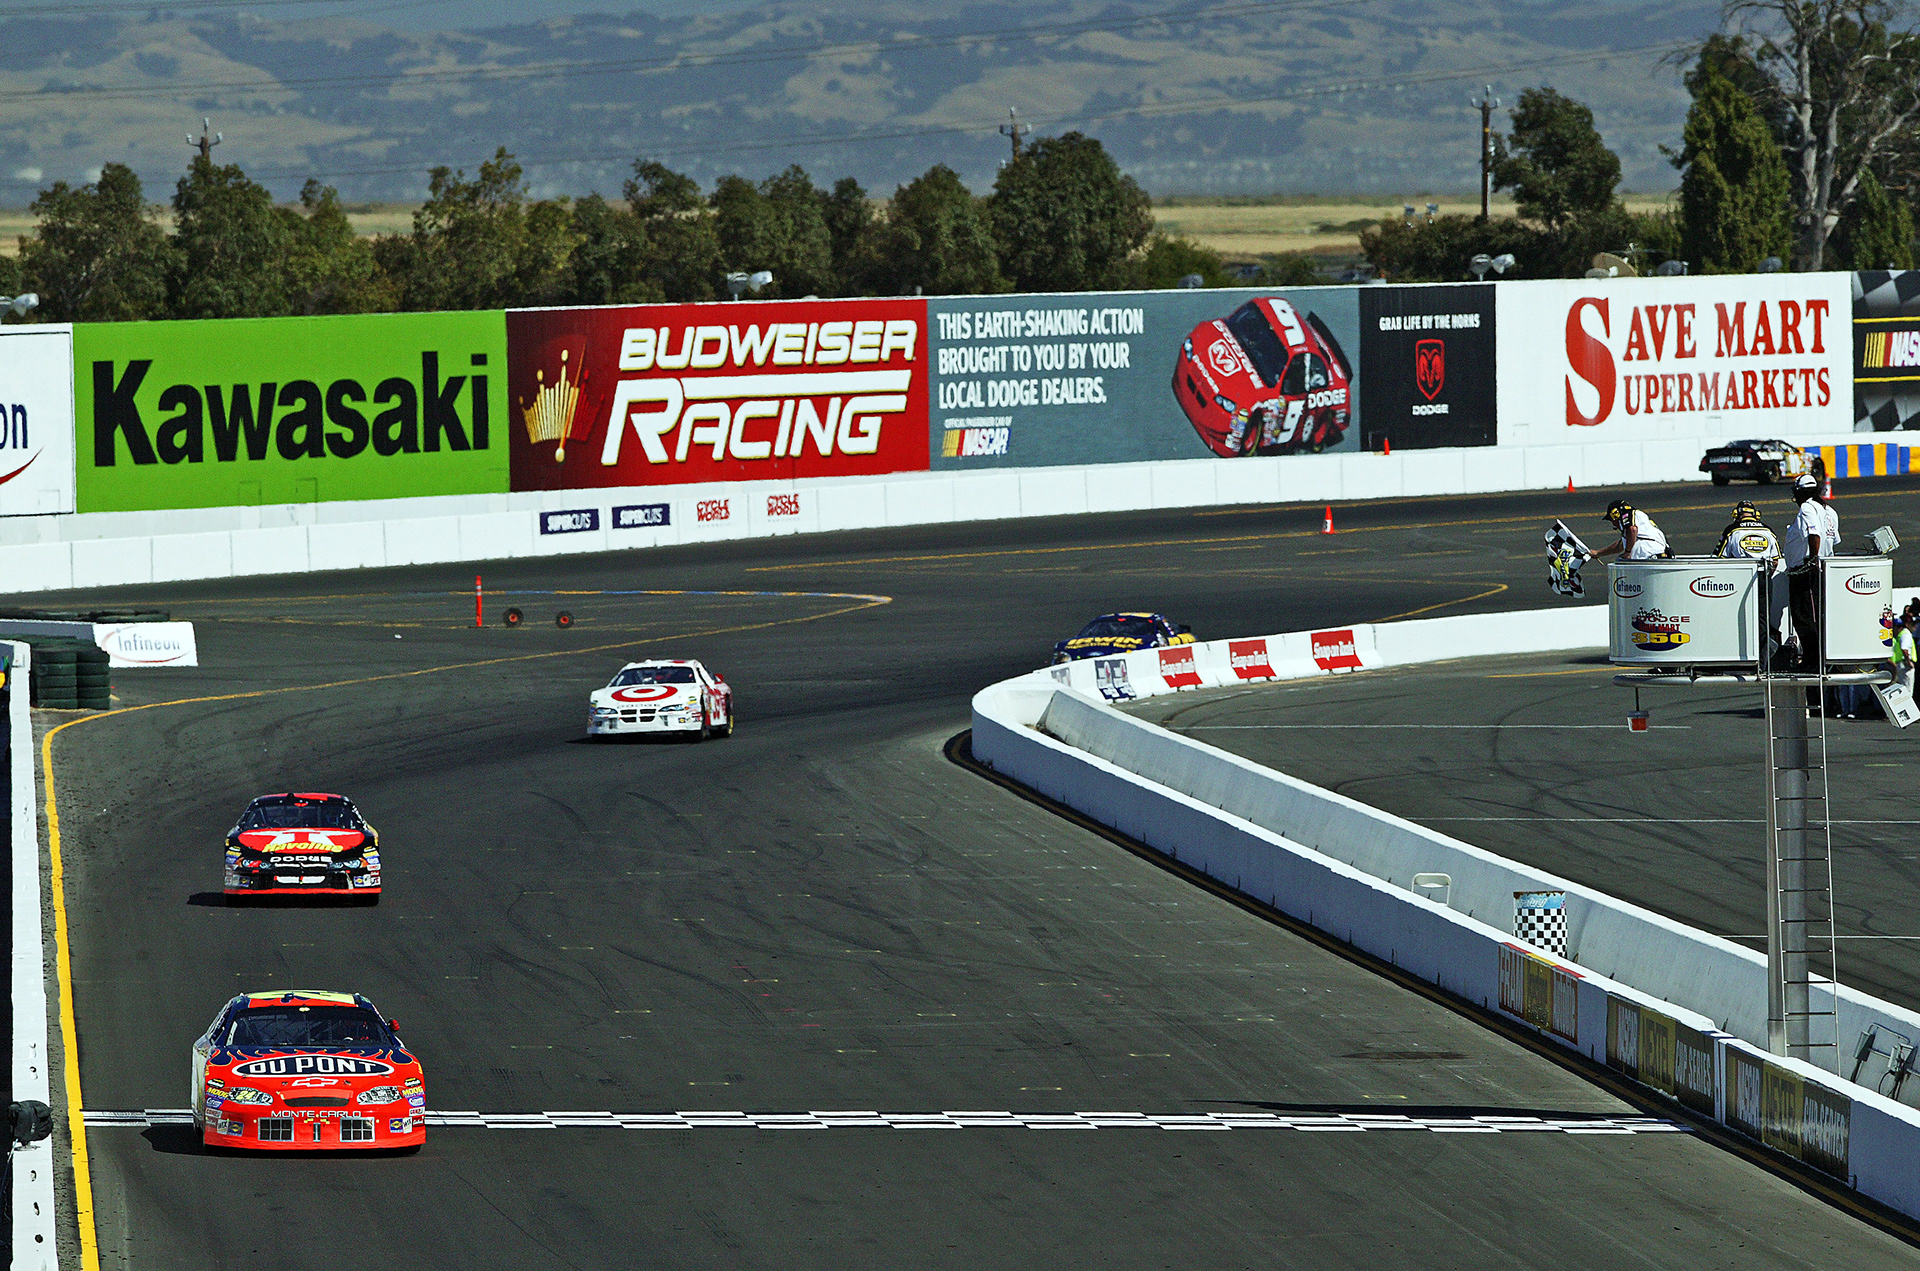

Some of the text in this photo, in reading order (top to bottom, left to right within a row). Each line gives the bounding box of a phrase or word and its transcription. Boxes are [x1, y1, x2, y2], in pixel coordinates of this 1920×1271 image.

[937, 308, 1144, 339] THIS EARTH-SHAKING ACTION
[1379, 316, 1402, 331] GRAB
[1403, 315, 1421, 330] LIFE
[1433, 314, 1450, 329] THE
[1714, 299, 1829, 358] MART
[618, 319, 918, 372] BUDWEISER
[938, 342, 1130, 375] BROUGHT TO YOU BY YOUR
[938, 376, 1107, 409] LOCAL DODGE DEALERS.
[1308, 388, 1347, 409] DODGE
[92, 351, 490, 467] Kawasaki
[1277, 400, 1306, 434] 9
[1412, 404, 1449, 415] DODGE
[601, 370, 912, 466] RACING
[962, 428, 1009, 456] NASCAR
[697, 499, 729, 510] CYCLE
[547, 513, 591, 532] SUPERCUTS
[697, 507, 730, 521] WORLD
[1067, 636, 1143, 646] IRWIN
[1631, 632, 1690, 644] 350
[261, 842, 344, 853] Havoline
[270, 855, 332, 863] DODGE
[249, 1056, 376, 1074] DU PONT
[206, 1087, 229, 1098] MOOG
[235, 1090, 257, 1101] 24
[401, 1086, 424, 1096] MOOG
[271, 1110, 362, 1118] MONTE CARLO
